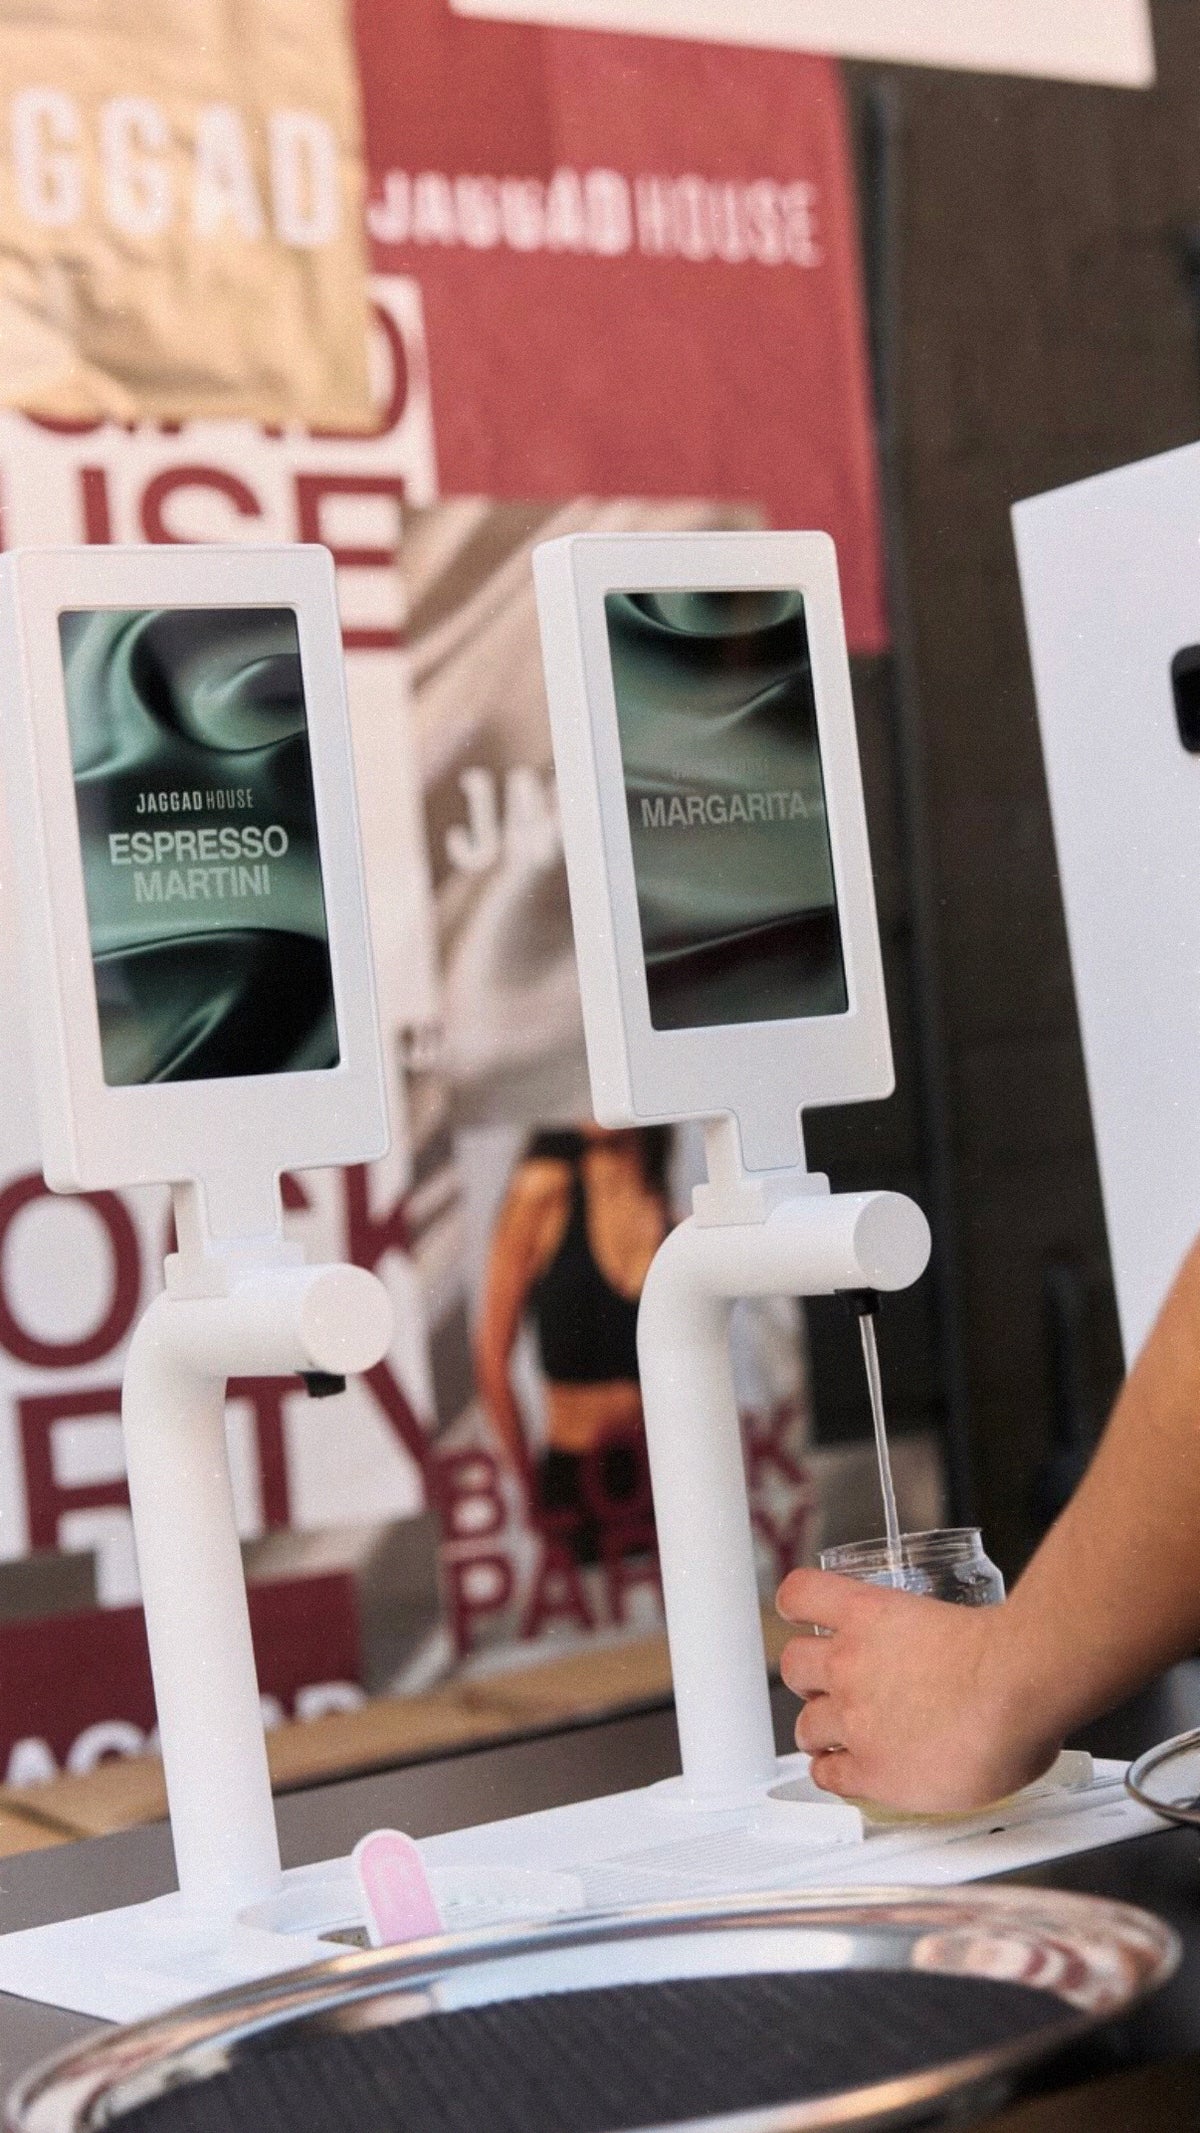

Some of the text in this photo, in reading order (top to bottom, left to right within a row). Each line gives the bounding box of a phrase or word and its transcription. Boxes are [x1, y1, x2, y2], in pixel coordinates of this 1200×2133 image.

[640, 791, 807, 828] MARGARITA
[108, 824, 289, 866] ESPRESSO
[133, 864, 271, 902] MARTINI
